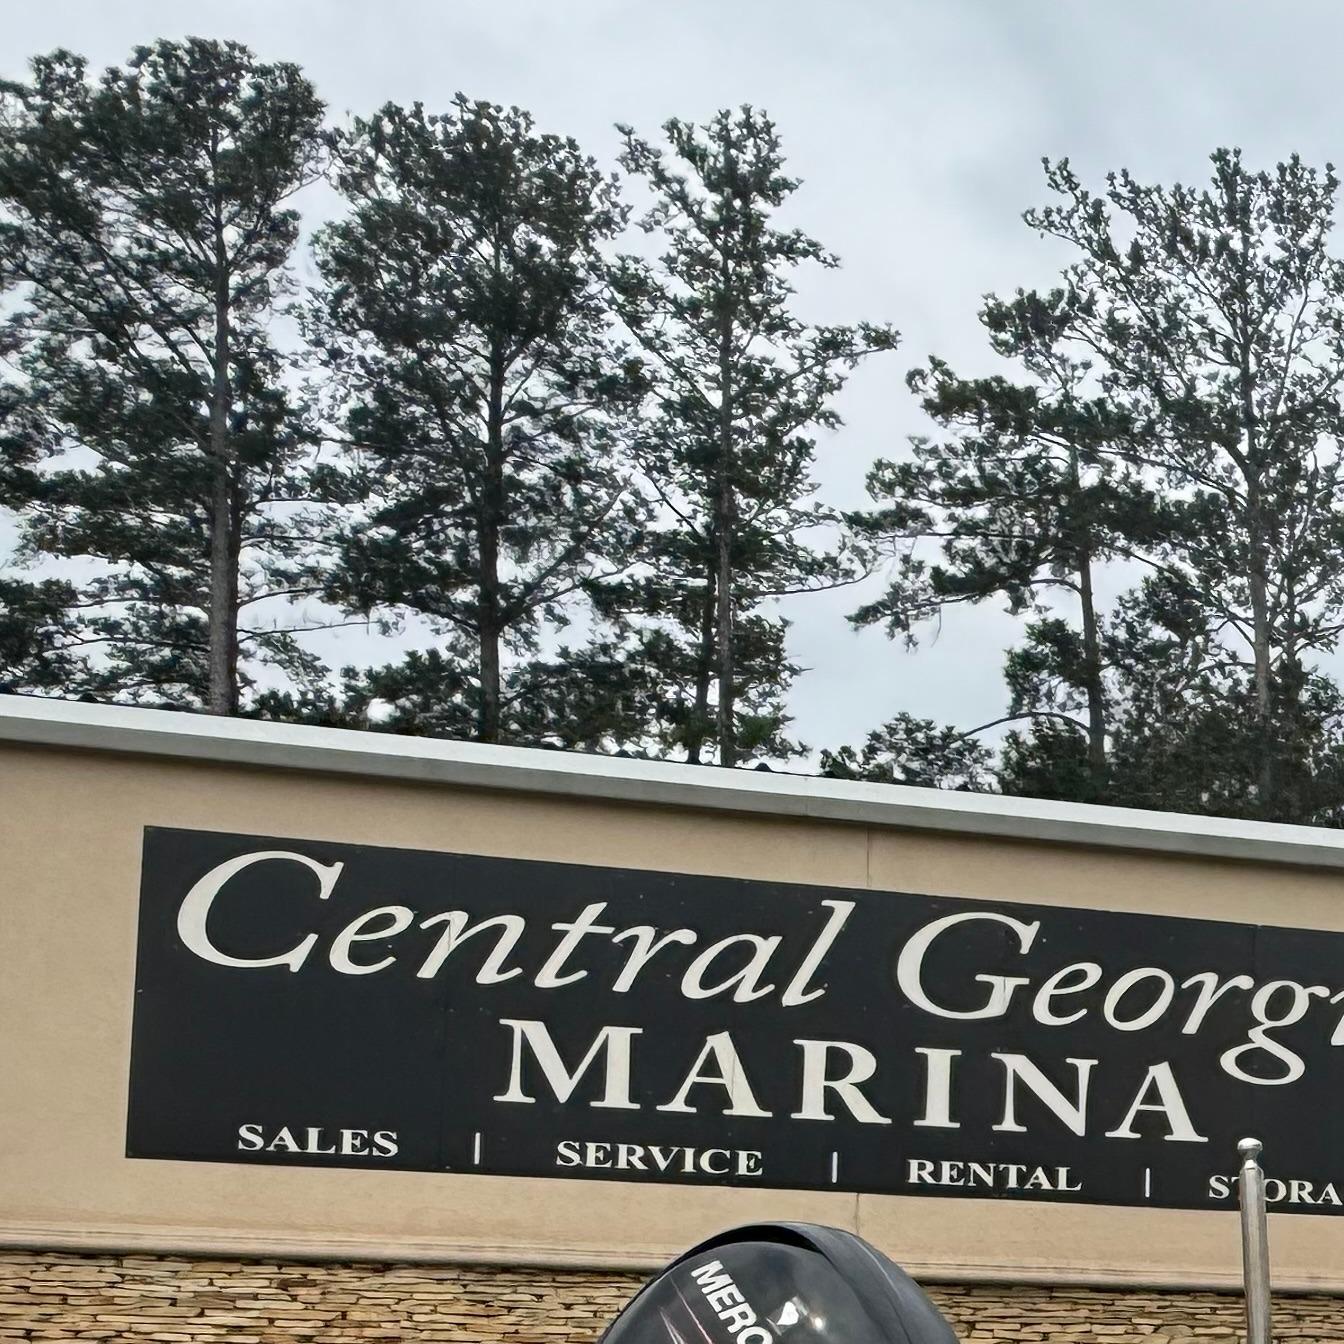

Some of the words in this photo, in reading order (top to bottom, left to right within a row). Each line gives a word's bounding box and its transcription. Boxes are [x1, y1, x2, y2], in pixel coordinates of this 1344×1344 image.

[177, 850, 856, 1008] Central
[492, 1018, 1209, 1143] MARINA
[237, 1123, 400, 1158] SALES
[556, 1140, 764, 1177] SERVICE
[908, 1159, 1083, 1192] RENTAL
